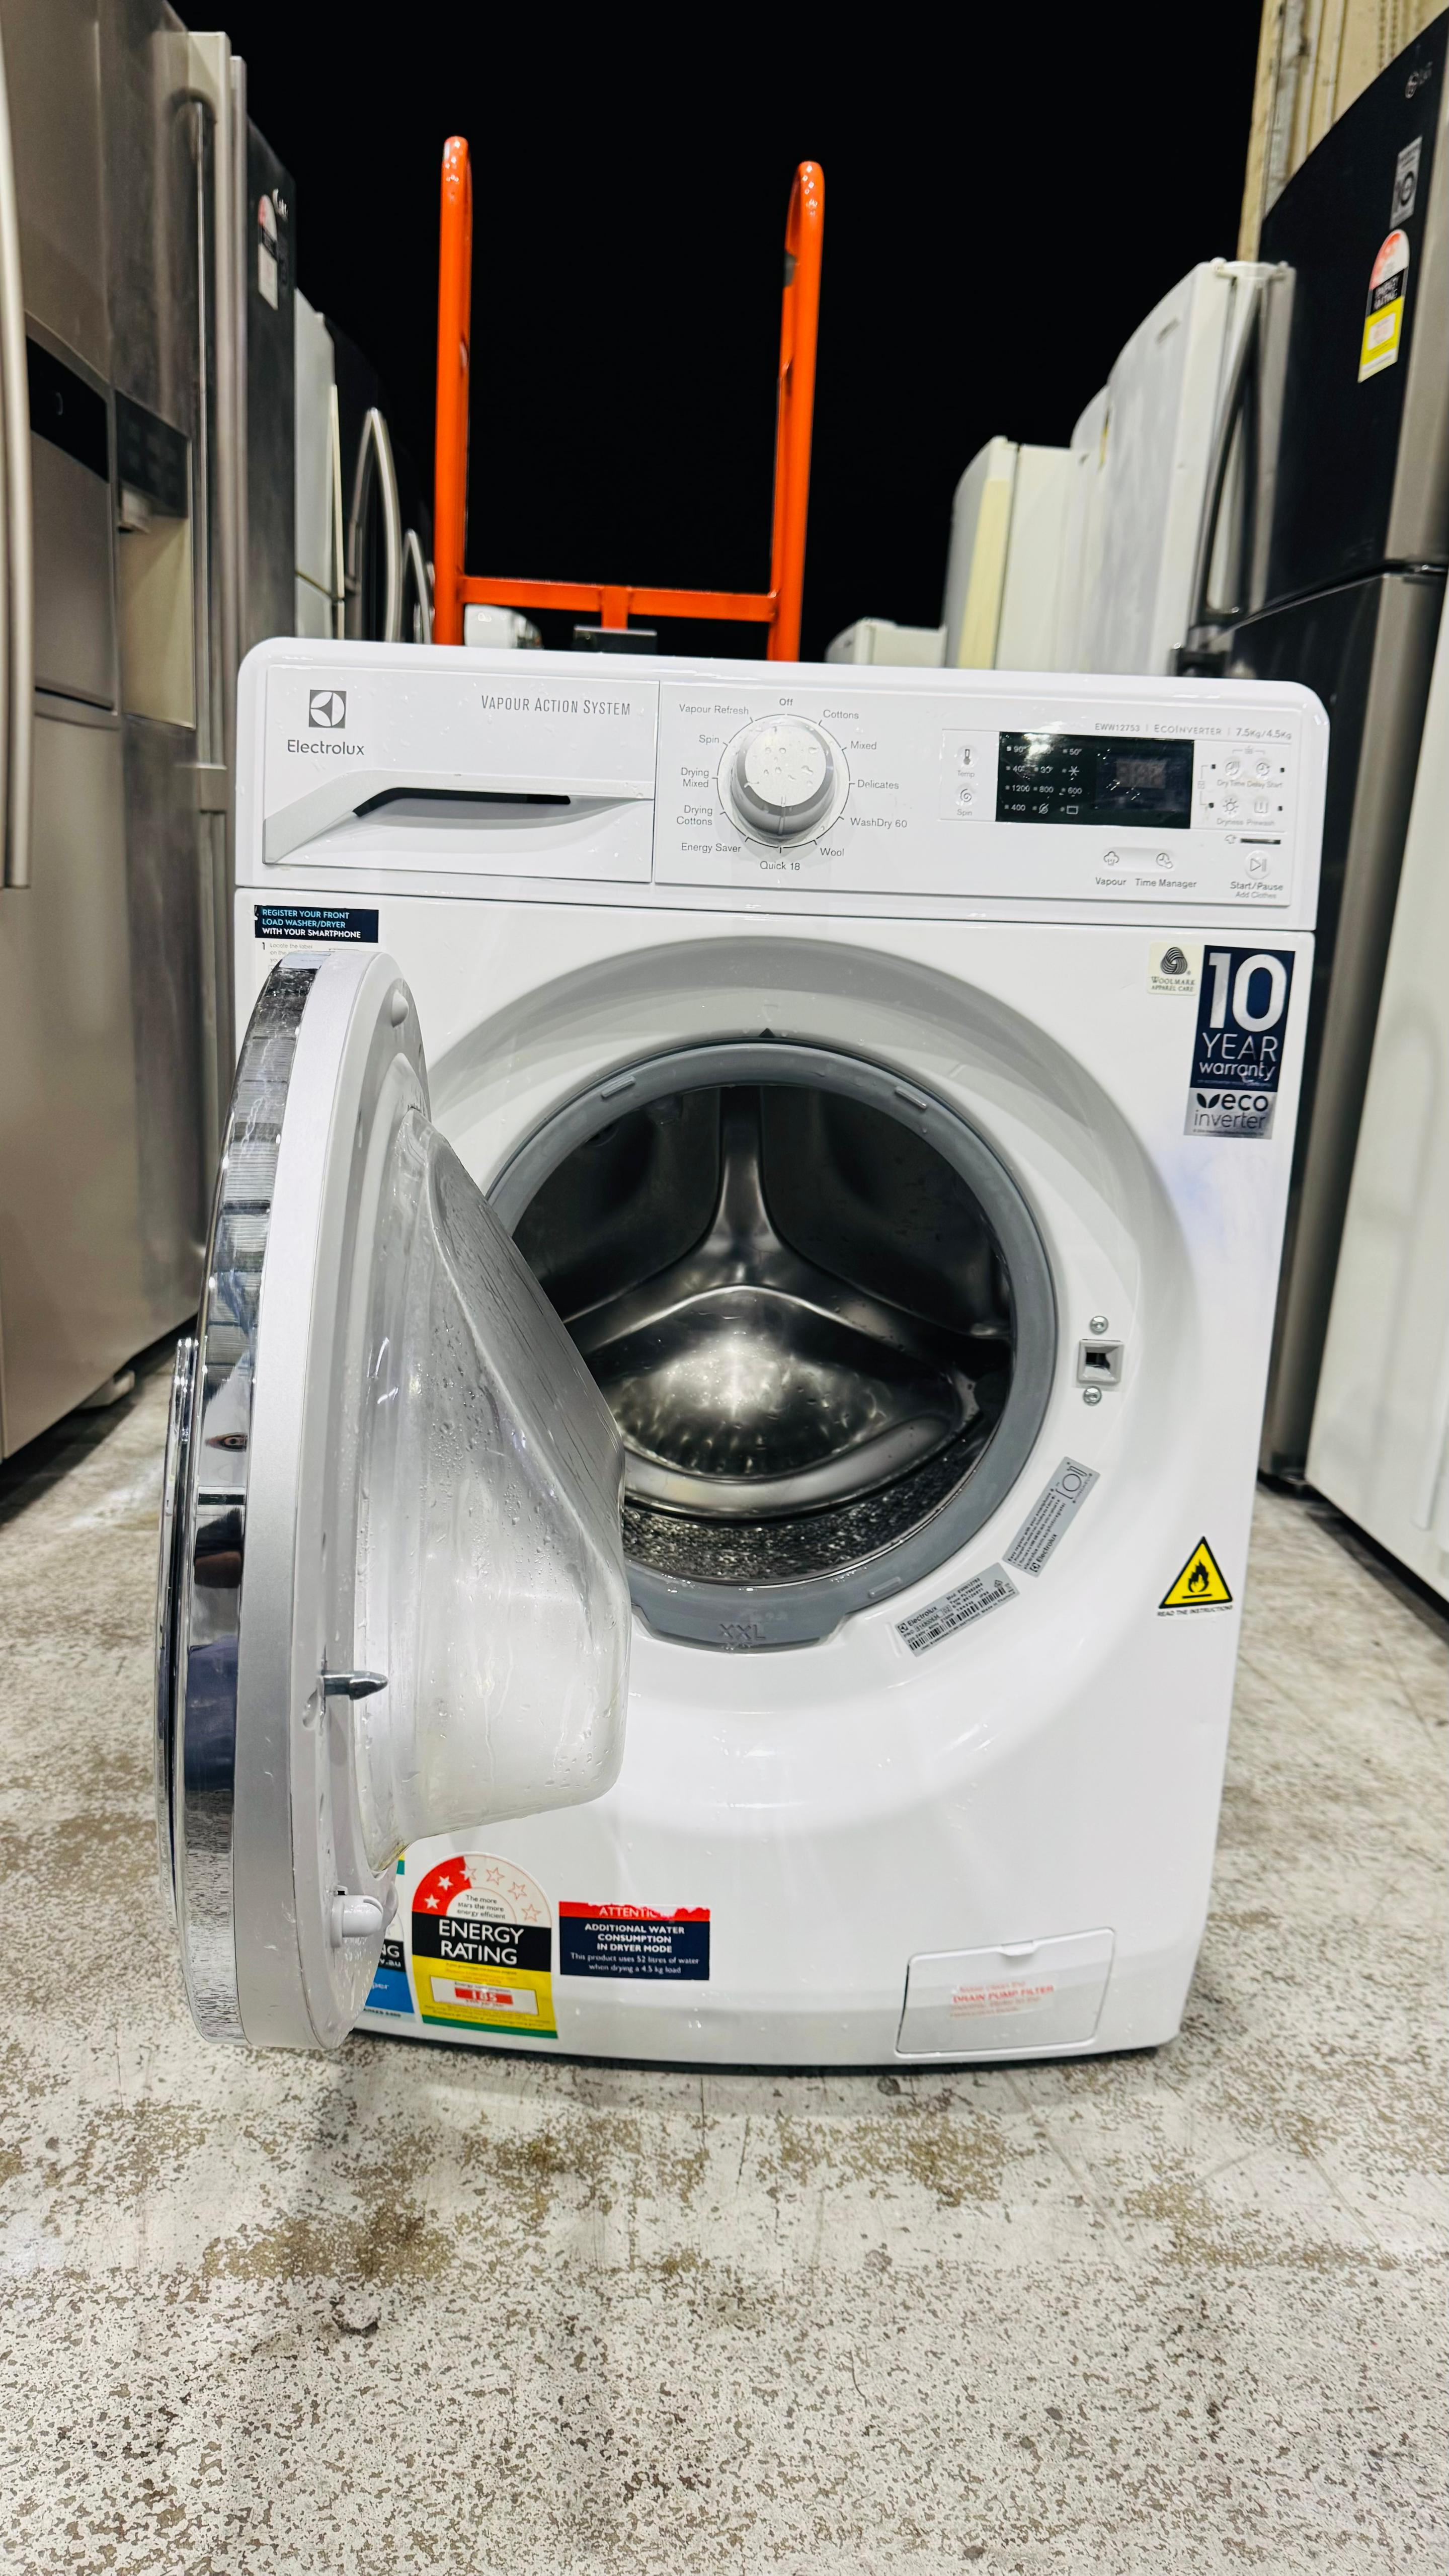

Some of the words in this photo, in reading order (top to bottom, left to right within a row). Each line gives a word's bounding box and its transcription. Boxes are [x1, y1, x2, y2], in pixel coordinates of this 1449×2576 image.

[481, 695, 529, 711] VAPOUR
[535, 697, 578, 713] ACTION
[584, 700, 631, 715] SYSTEM
[679, 705, 711, 715] Vapour
[714, 705, 749, 715] Refresh
[823, 710, 859, 719] Cottons
[1095, 723, 1140, 732] EWW12753
[699, 735, 719, 745] Spin
[287, 740, 364, 756] Electrolux
[851, 741, 877, 750] Mixed
[681, 768, 709, 778] Drying
[957, 770, 975, 778] Temp
[683, 779, 709, 788] Mixed
[858, 780, 899, 789] Delicates
[684, 806, 712, 817] Drying
[957, 809, 972, 818] Spin
[677, 817, 712, 826] Cottons
[851, 818, 892, 829] WashDry
[895, 819, 907, 828] 60
[681, 843, 712, 854] Energy
[715, 844, 741, 853] Saver
[821, 848, 844, 857] Wool
[760, 861, 786, 871] Quick
[790, 862, 800, 871] 18
[1095, 877, 1126, 887] Vapour
[1135, 878, 1156, 887] Time
[1159, 879, 1196, 889] Manager
[1230, 881, 1283, 891] Start/Pause
[263, 909, 297, 917] REGISTER
[299, 910, 321, 918] YOUR
[285, 919, 346, 928] WASHER/DRYER
[307, 929, 361, 938] SMARTPHONE
[262, 942, 265, 950] 1
[1152, 976, 1195, 985] WOOLMARK
[1209, 952, 1287, 1032] 10
[1202, 1032, 1278, 1062] YEAR
[1199, 1062, 1276, 1083] warranty
[1222, 1093, 1269, 1112] eco
[1194, 1110, 1266, 1129] inverter
[1035, 1533, 1057, 1562] Electrolux
[907, 1605, 937, 1626] Electrolux
[719, 1623, 766, 1640] XXL
[466, 1894, 478, 1902] The
[457, 1909, 478, 1917] energy
[439, 1919, 524, 1945] ENERGY
[585, 1923, 647, 1934] ADDITIONAL
[648, 1926, 685, 1935] WATER
[598, 1934, 672, 1944] CONSUMPTION
[441, 1940, 517, 1965] RATING
[610, 1944, 641, 1952] DRYER
[643, 1945, 672, 1953] MODE
[570, 1952, 586, 1960] This
[588, 1953, 616, 1962] product
[611, 1964, 634, 1973] drying
[654, 1965, 664, 1974] kg
[665, 1966, 681, 1974] load
